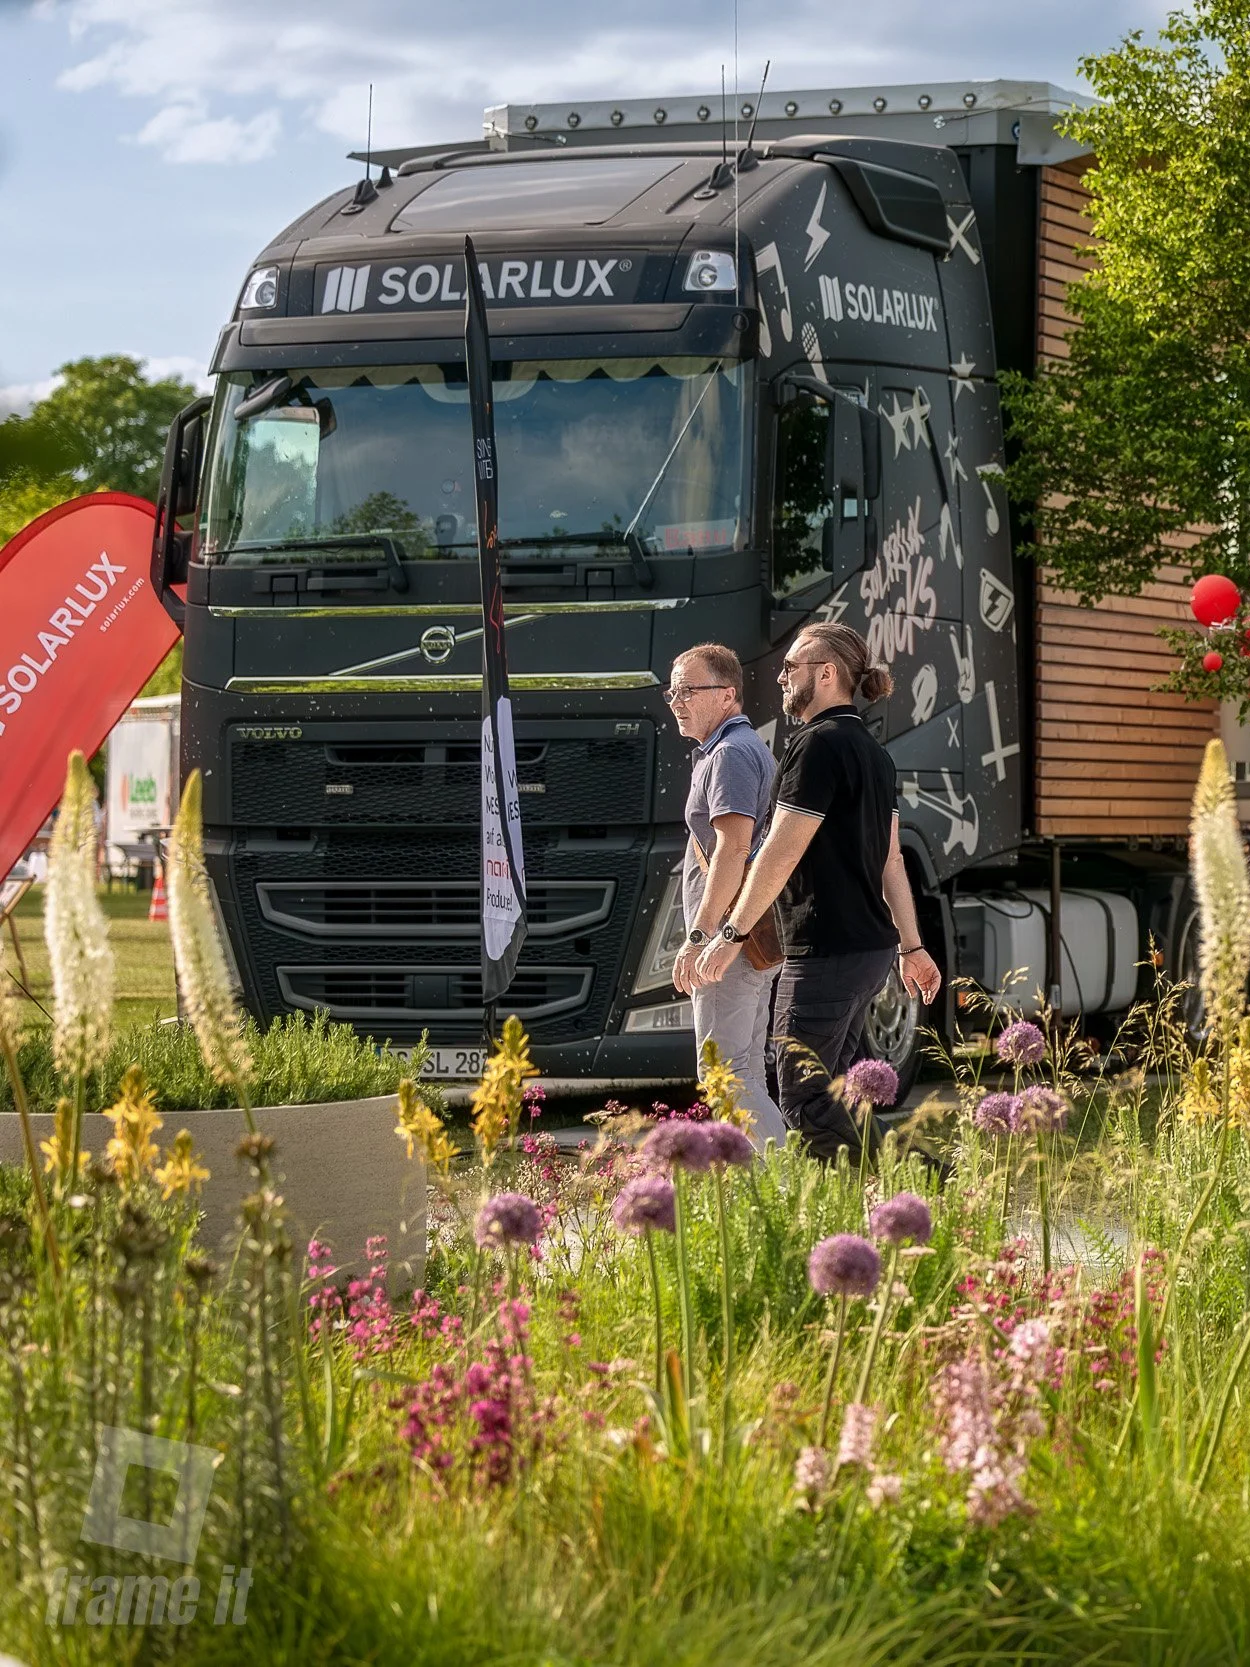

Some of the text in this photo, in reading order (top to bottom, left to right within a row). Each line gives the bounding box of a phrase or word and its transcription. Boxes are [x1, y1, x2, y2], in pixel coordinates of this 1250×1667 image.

[100, 577, 145, 634] solarlux.com
[0, 550, 127, 715] SOLARLUX
[236, 726, 302, 739] VOLVO
[615, 723, 640, 735] FH
